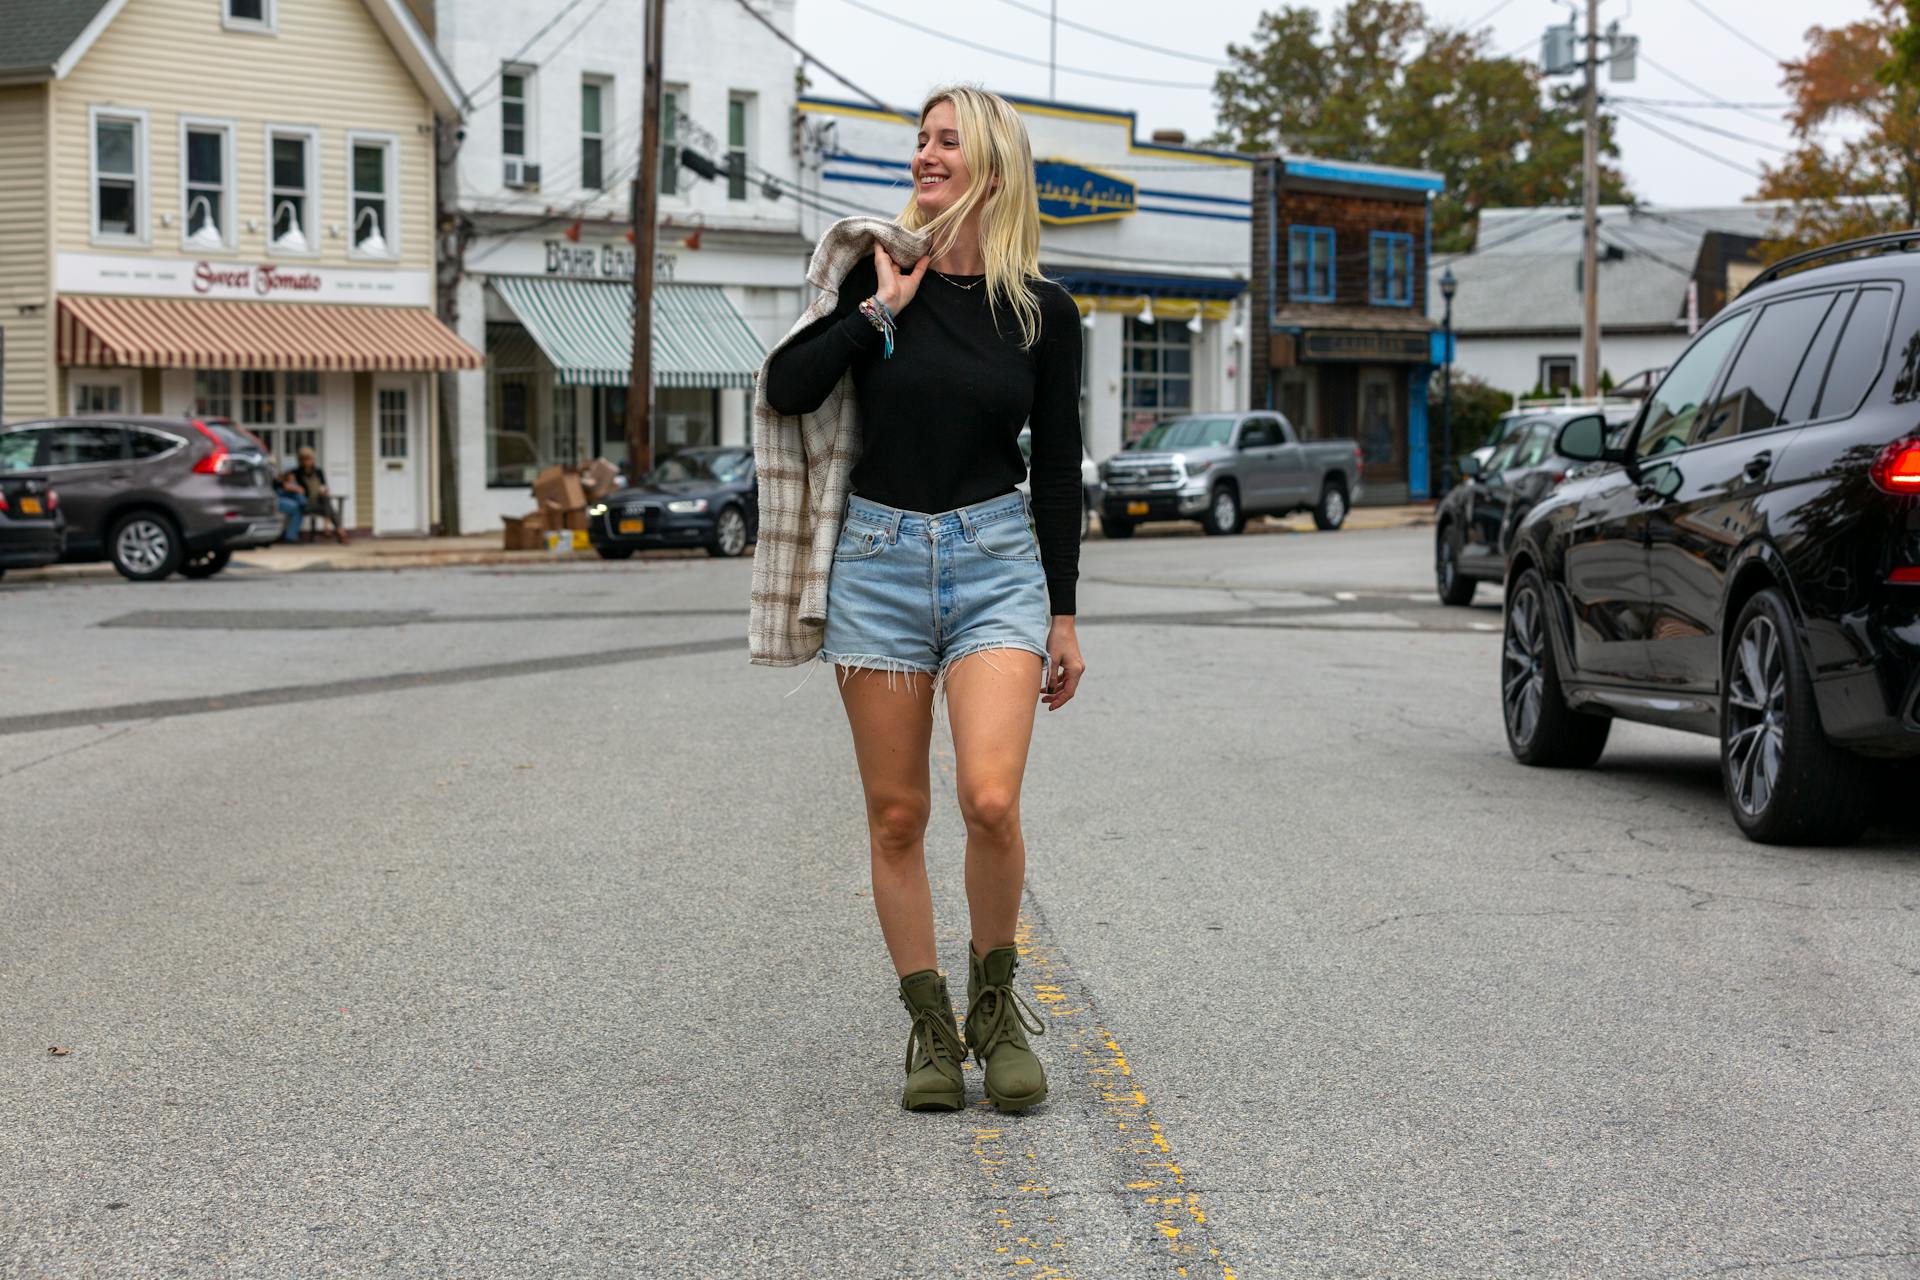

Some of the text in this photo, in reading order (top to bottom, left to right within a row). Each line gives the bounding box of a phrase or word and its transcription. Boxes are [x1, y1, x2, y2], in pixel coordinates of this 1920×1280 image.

[1082, 180, 1135, 214] Cycles
[543, 240, 678, 281] BAHR GALRY
[192, 261, 321, 295] Sweet Tomato
